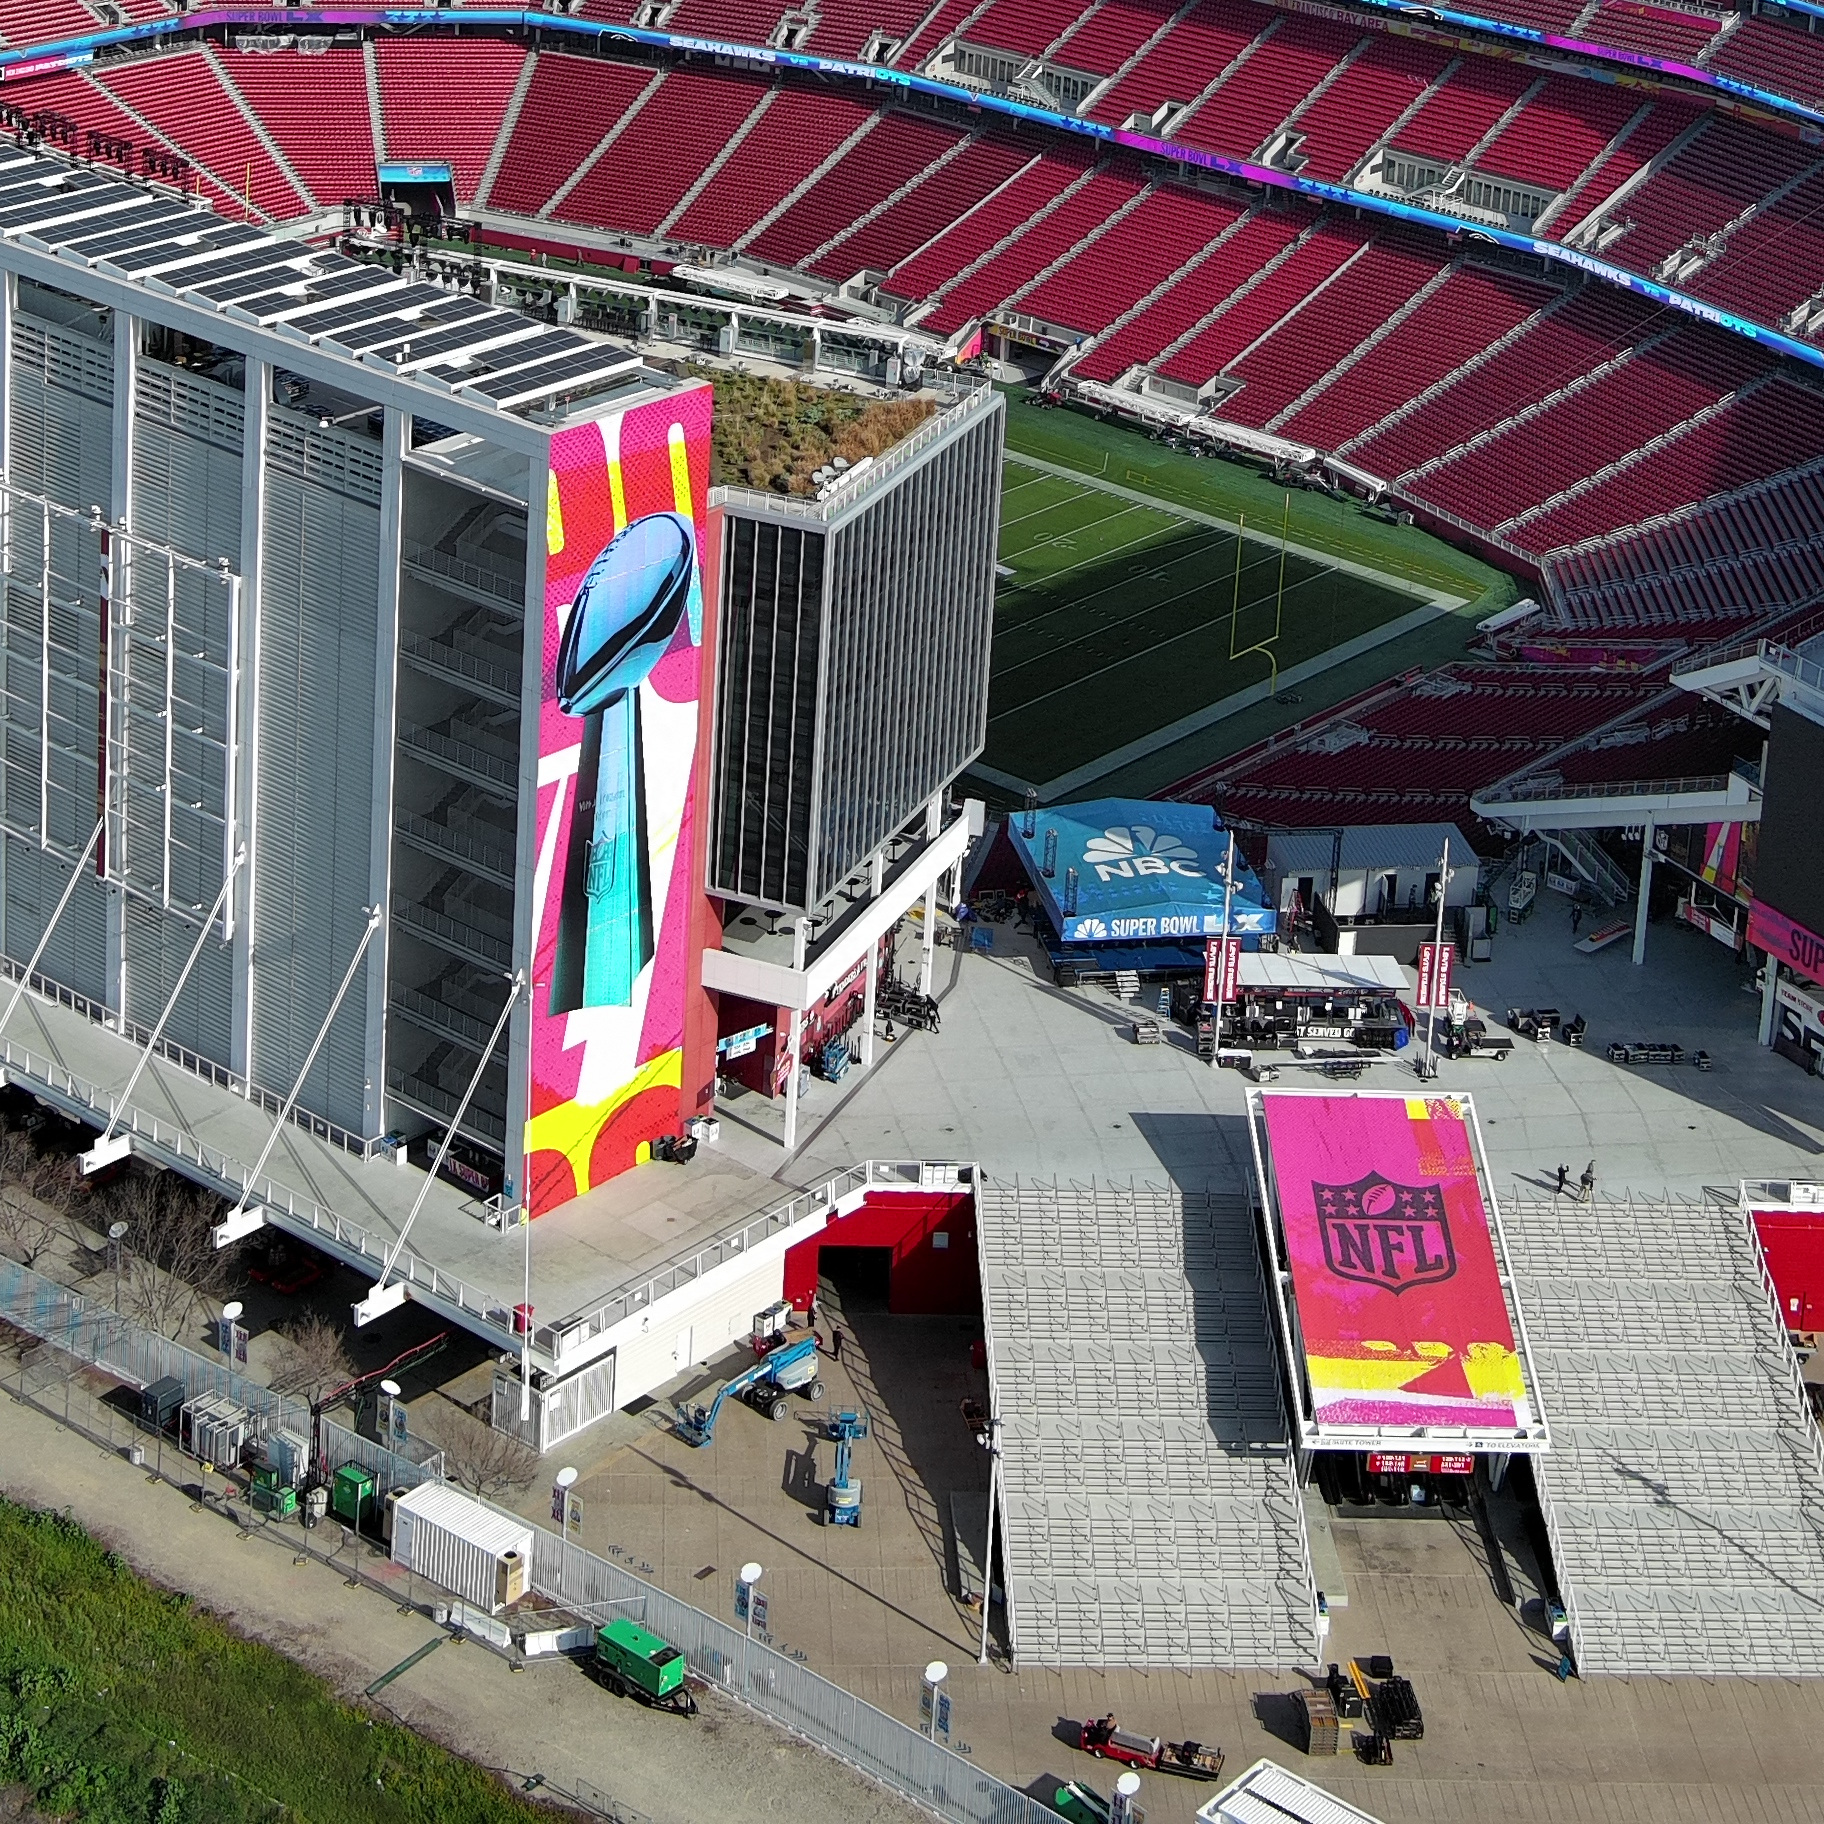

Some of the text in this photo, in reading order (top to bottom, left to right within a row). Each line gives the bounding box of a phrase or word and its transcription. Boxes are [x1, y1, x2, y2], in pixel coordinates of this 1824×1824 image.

[227, 11, 323, 22] SUPER BOWL LX
[1337, 11, 1357, 24] BAY
[1360, 16, 1388, 31] AREA
[669, 37, 911, 86] SEAHAWKS PATRIOTS
[1637, 56, 1662, 68] LX
[1161, 142, 1242, 172] SUPER BOWL LX
[1533, 241, 1757, 337] SEAHAWKS PATRIOTS
[1095, 856, 1206, 883] NBC
[1111, 913, 1264, 937] SUPER BOWL LX
[1781, 988, 1813, 1014] TEAM STORE
[1307, 1027, 1341, 1037] SERVED
[1782, 1007, 1824, 1053] SF
[1332, 1223, 1444, 1280] NFL
